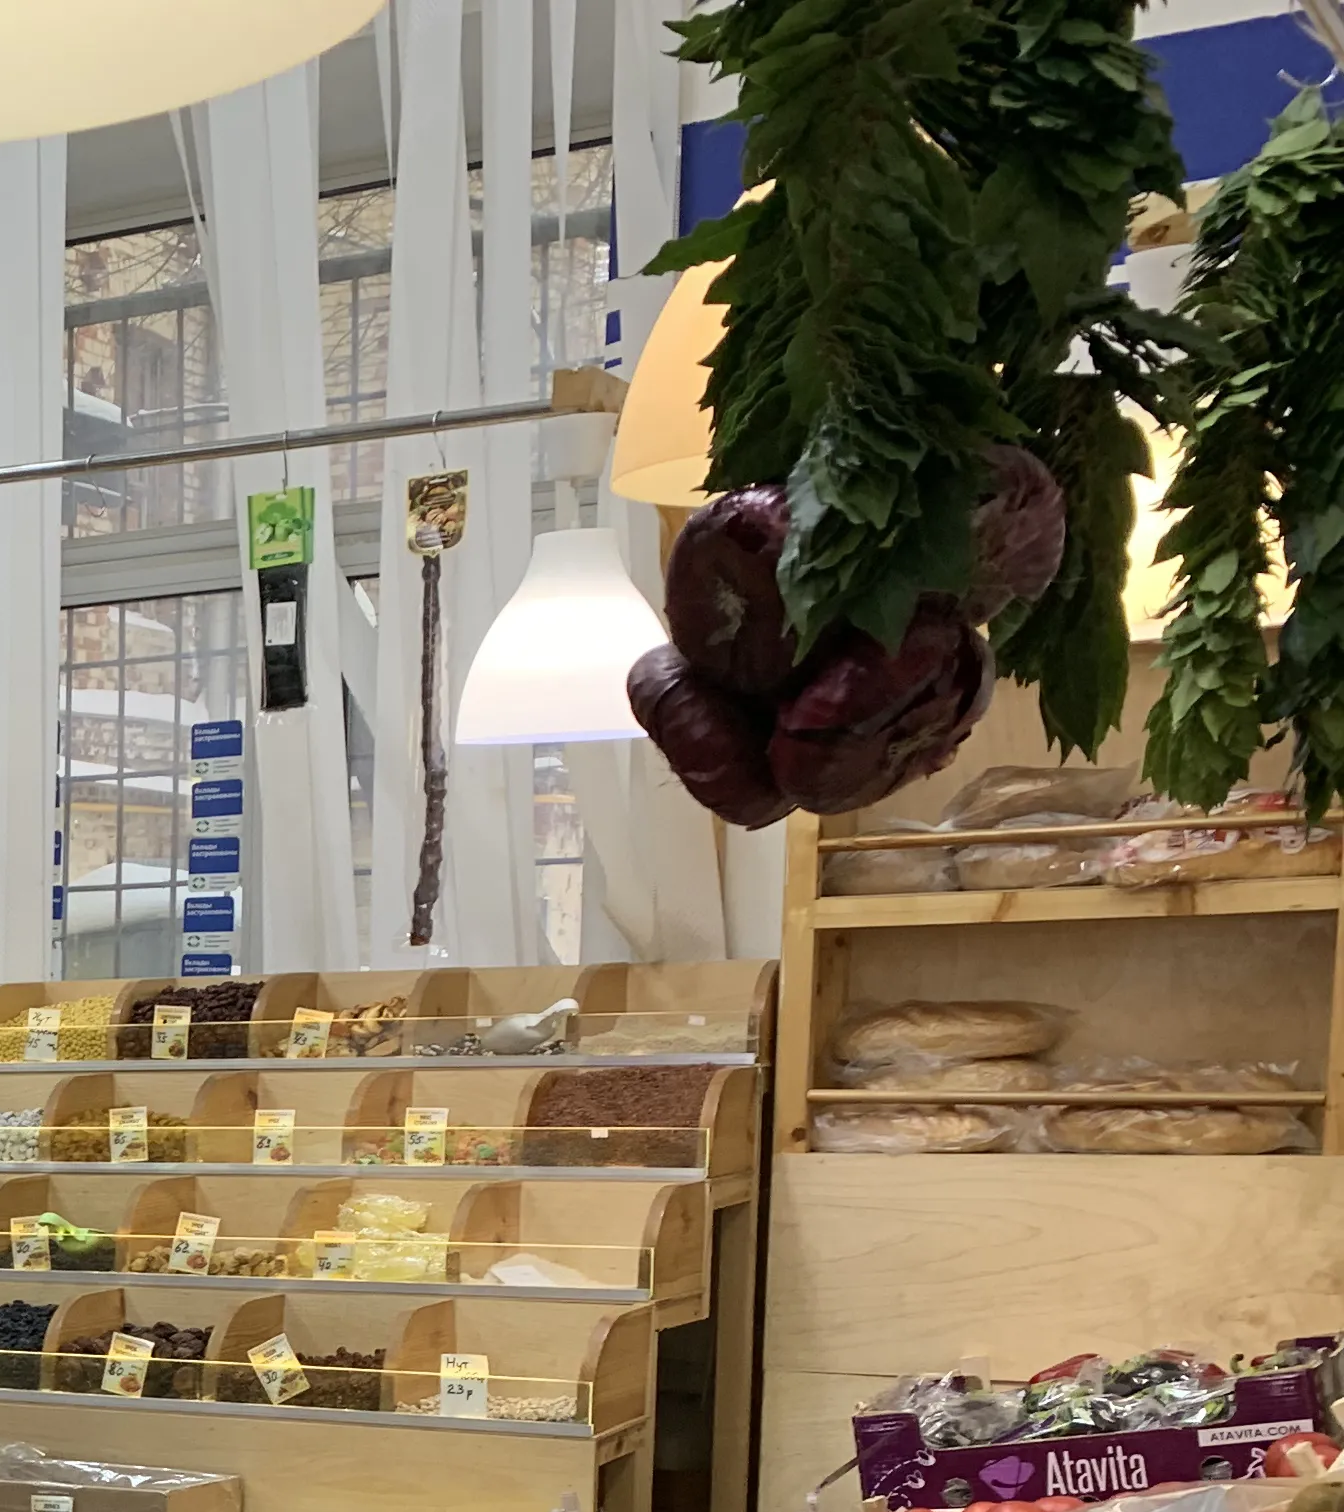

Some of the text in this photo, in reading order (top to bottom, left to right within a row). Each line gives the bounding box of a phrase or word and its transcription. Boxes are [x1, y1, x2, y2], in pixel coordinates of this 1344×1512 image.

[194, 727, 220, 736] Вклады
[194, 786, 221, 795] Вклады
[191, 843, 217, 851] Вклады
[187, 902, 212, 911] Вклады
[184, 959, 210, 967] Вклады
[446, 1357, 469, 1370] Нут
[1209, 1422, 1303, 1443] ATAVITA.COM
[1046, 1446, 1149, 1498] Atavita
